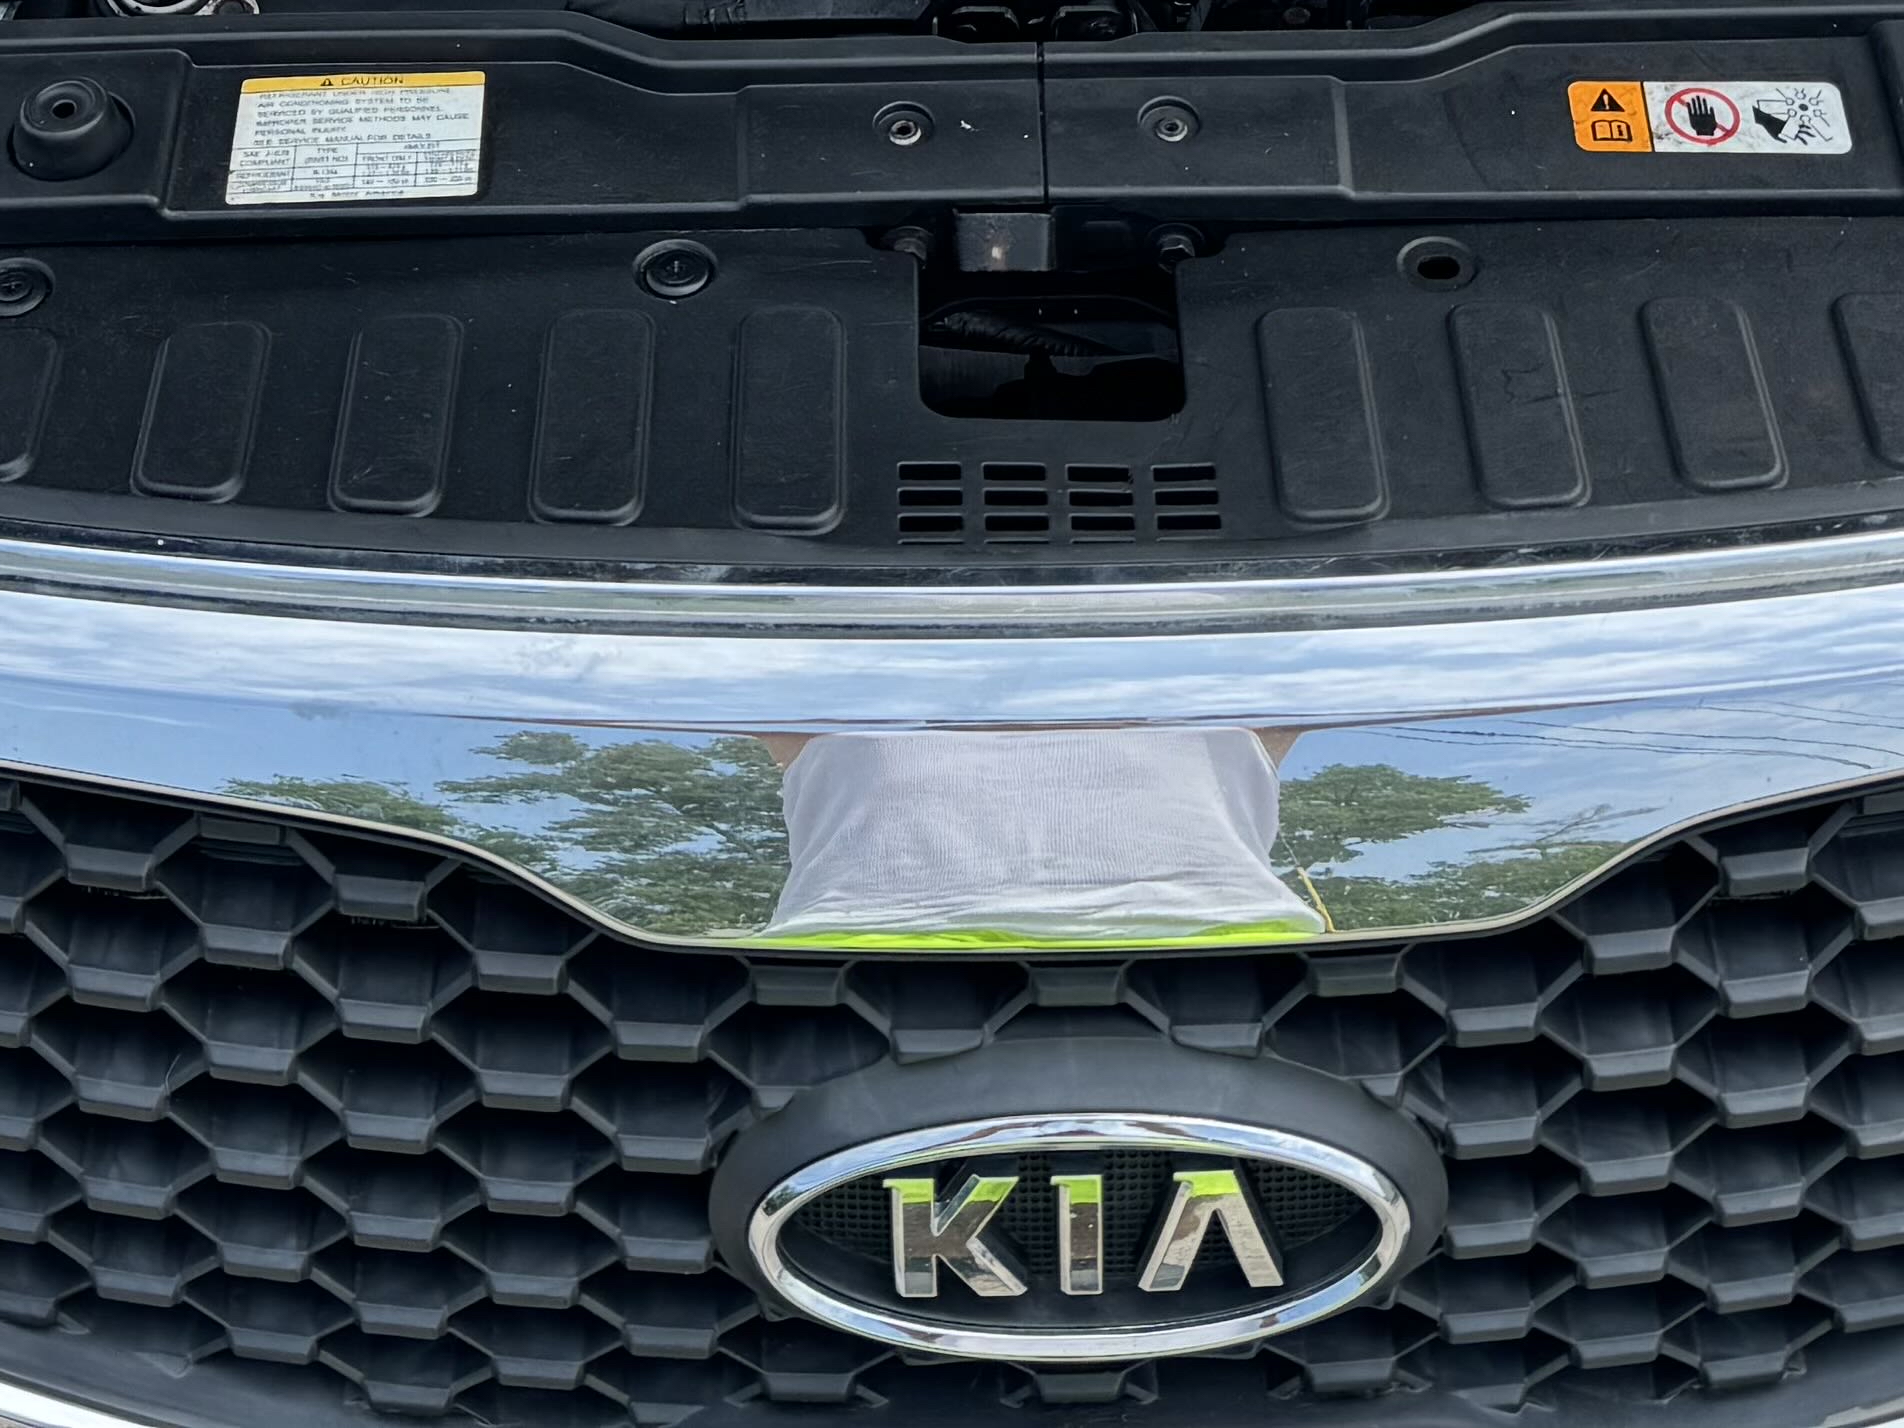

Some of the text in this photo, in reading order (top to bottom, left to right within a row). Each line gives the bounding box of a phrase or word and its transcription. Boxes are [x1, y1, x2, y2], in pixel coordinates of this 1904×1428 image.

[341, 76, 403, 86] CAUTION
[355, 97, 394, 105] SYSTEM
[359, 115, 406, 123] METHODS
[412, 114, 432, 122] MAY
[436, 112, 470, 121] CAUSE
[255, 128, 306, 136] PERSONAL
[882, 1168, 1286, 1298] KIA
